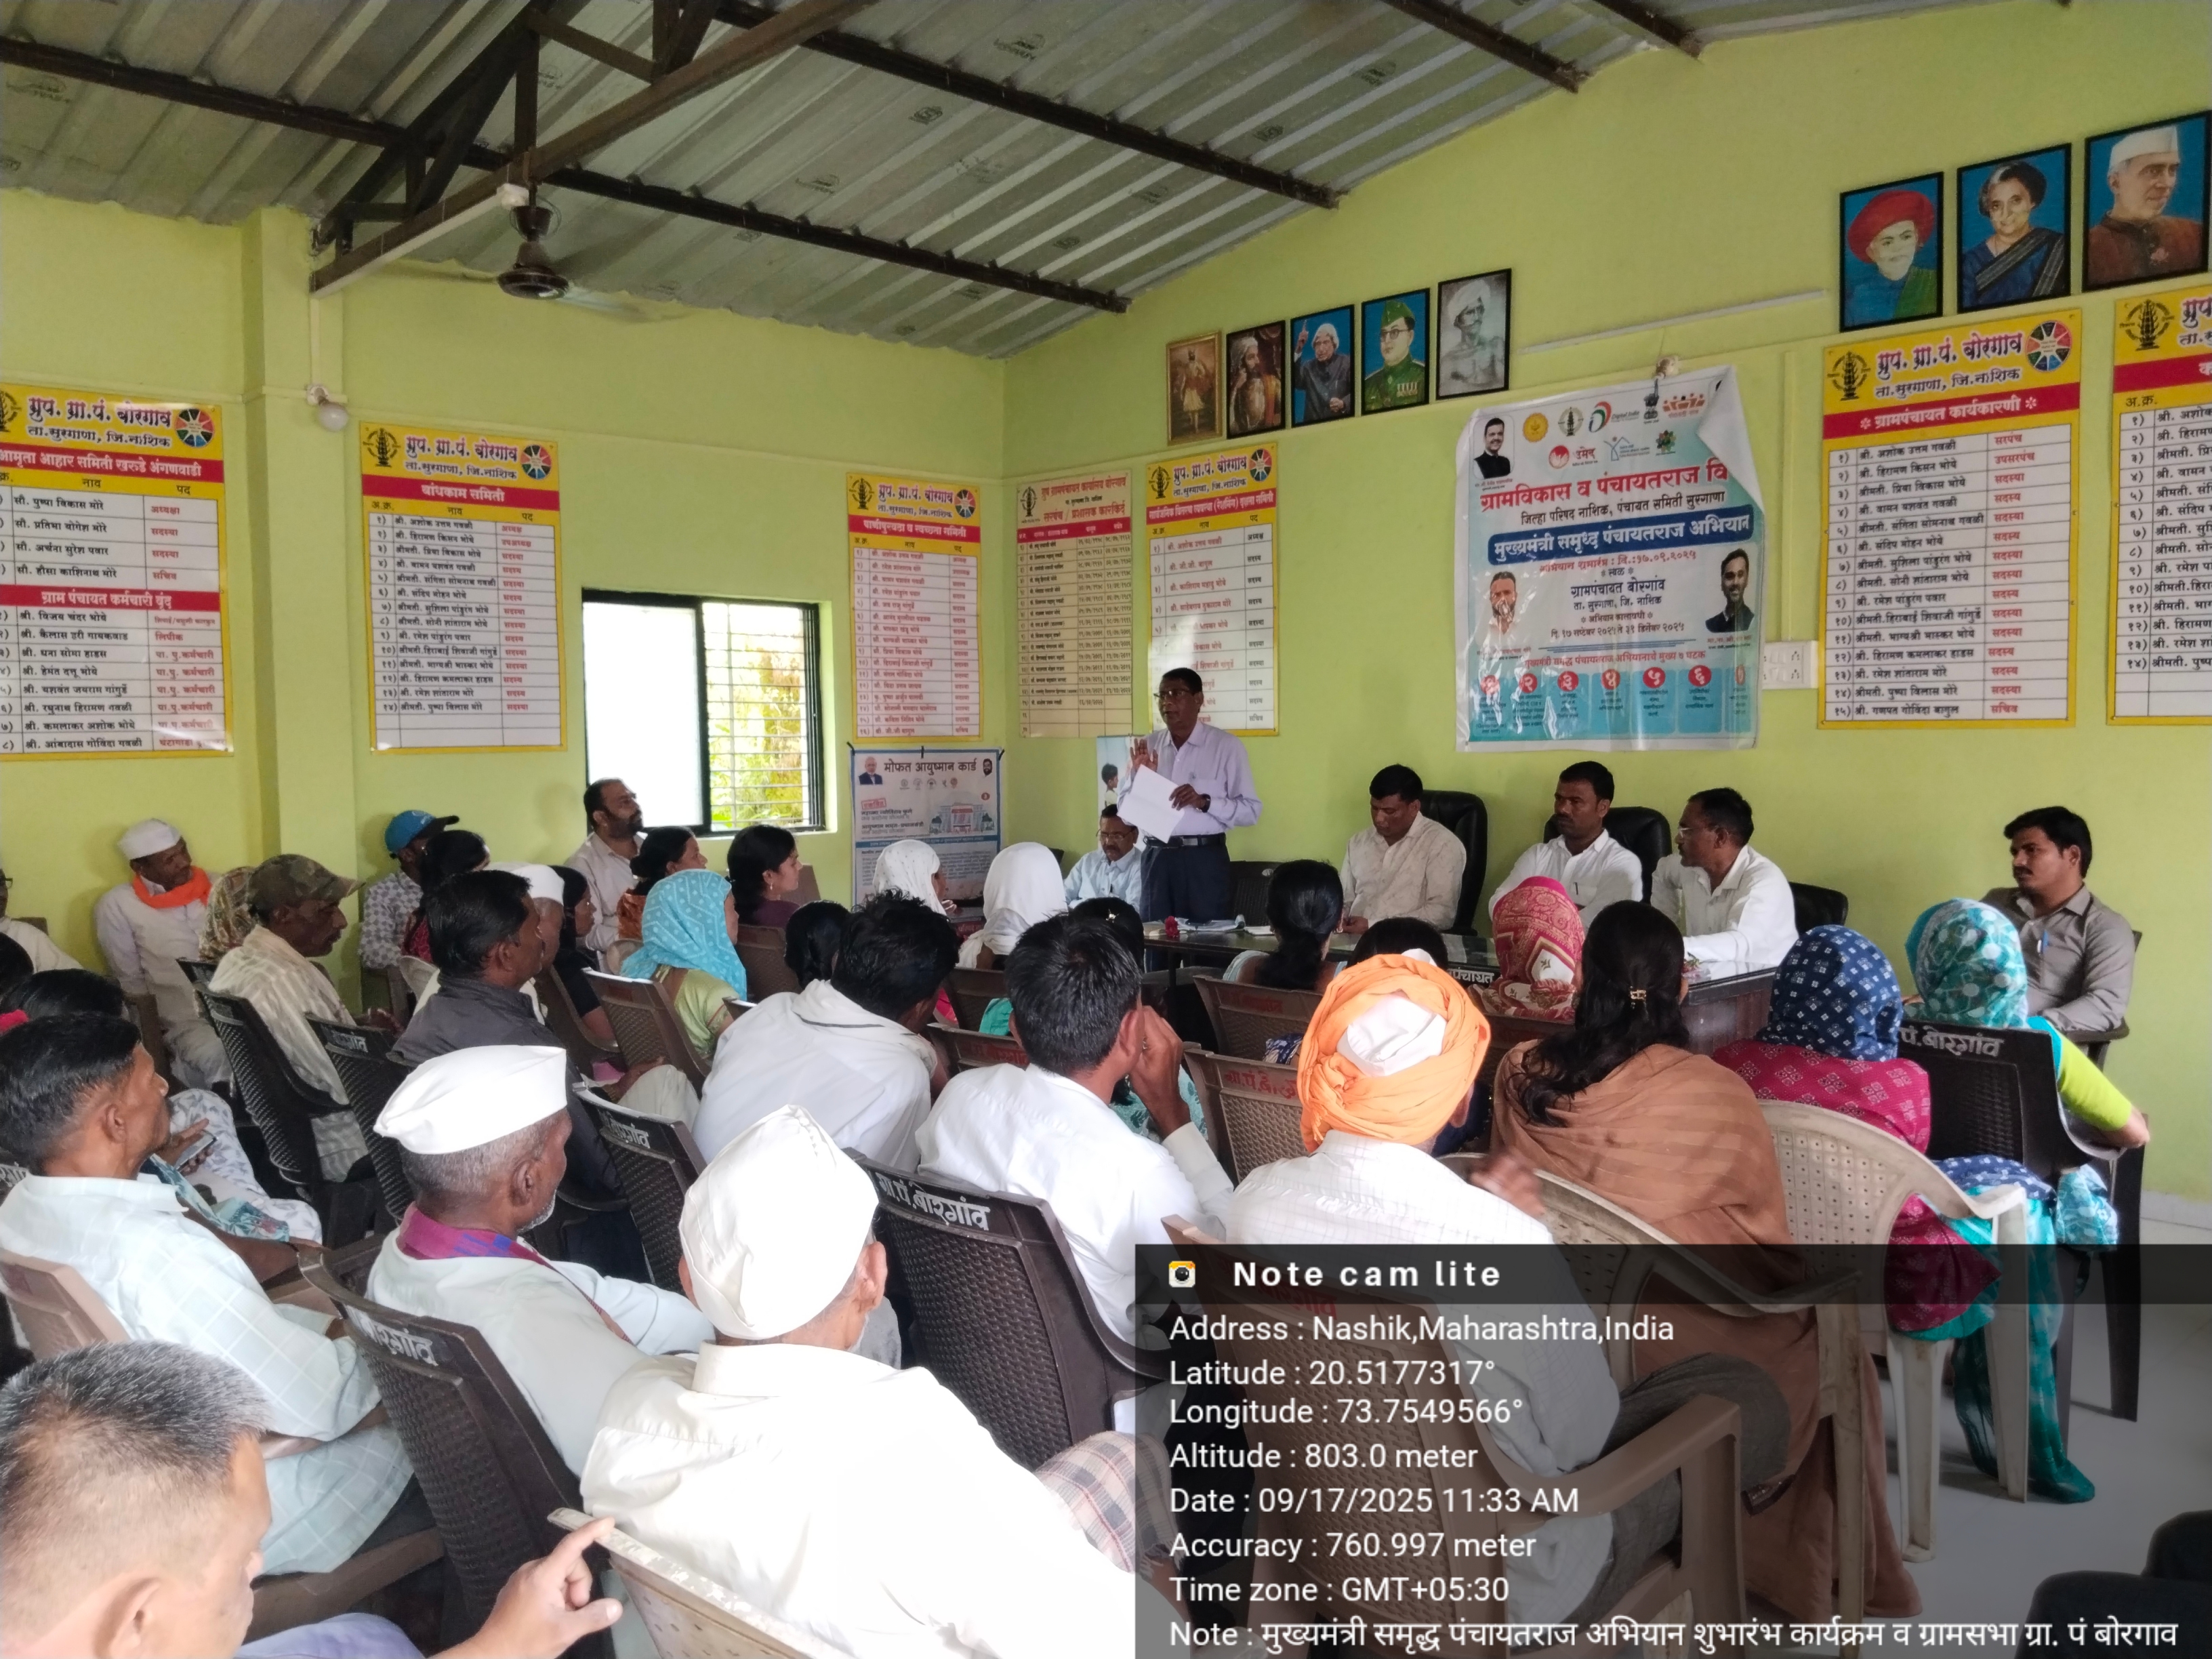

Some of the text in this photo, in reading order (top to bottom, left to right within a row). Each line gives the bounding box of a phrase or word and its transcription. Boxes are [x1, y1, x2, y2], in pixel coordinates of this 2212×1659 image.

[1963, 333, 2022, 360] बोरगाव
[117, 401, 171, 427] बोरगाव
[1875, 394, 2022, 429] ग्रामपंचायत कार्यकारणी
[1994, 431, 2022, 445] सरपंच
[474, 439, 518, 462] बोरगाव
[40, 452, 75, 468] आहार
[77, 453, 113, 470] समिती
[150, 458, 201, 476] अंगणवाडी
[82, 478, 101, 488] नाव
[177, 485, 190, 495] पद
[422, 483, 505, 502] बांधकाम समिती
[1480, 457, 1727, 512] ग्रामविकास व पंचायतराज वि
[1521, 511, 1546, 526] जिल्हा
[1578, 502, 1613, 518] नाशिक,
[1617, 498, 1650, 513] पंचायत
[1652, 492, 1683, 510] समिती
[1686, 491, 1725, 510] सुरगाणा
[1494, 532, 1555, 562] मुख्यमंत्री
[1603, 525, 1685, 544] पंचायतराज
[1689, 514, 1750, 535] अभियान
[41, 590, 66, 605] ग्राम
[68, 588, 107, 606] पंचायत
[110, 590, 152, 607] कर्मचारी
[1570, 575, 1666, 598] ग्रामपंचायत बोरगांव
[1637, 594, 1662, 605] नाशिक
[884, 758, 977, 775] मोफत आयुष्मान कार्ड
[1898, 1025, 2005, 1057] पं.बोरगांव
